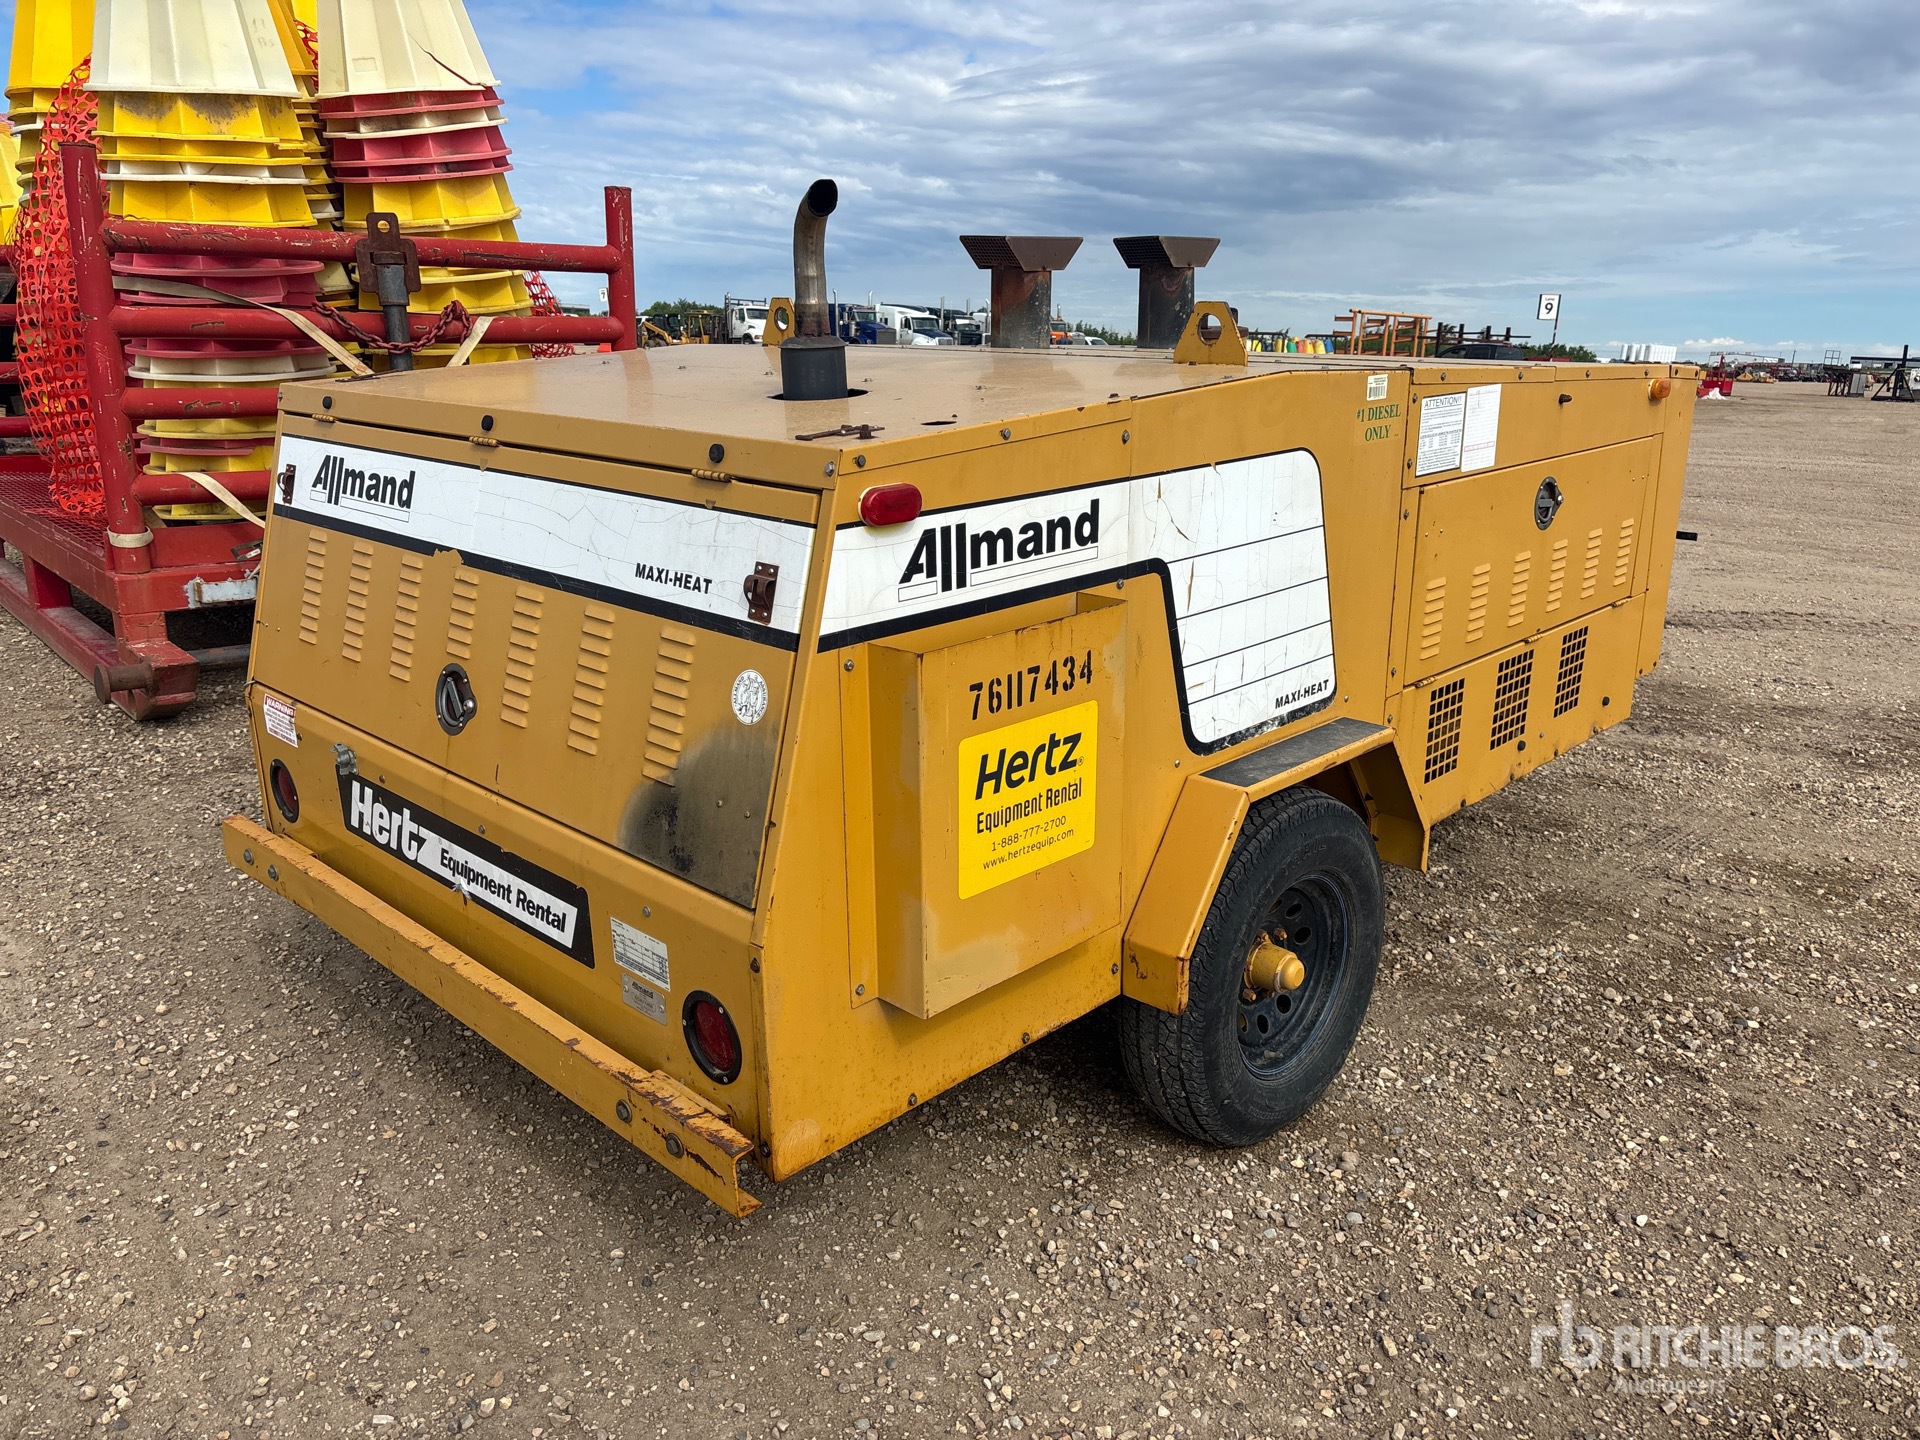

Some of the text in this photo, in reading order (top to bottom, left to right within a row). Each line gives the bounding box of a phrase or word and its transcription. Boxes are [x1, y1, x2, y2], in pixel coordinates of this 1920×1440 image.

[1544, 302, 1554, 315] 9
[1356, 404, 1401, 422] #1 DIESEL
[1364, 424, 1391, 442] ONLY
[312, 454, 416, 509] Allmand
[899, 498, 1100, 593] Allmand
[635, 562, 712, 594] MAXI-HEAT
[969, 650, 1093, 720] 76117434
[1275, 679, 1329, 709] MAXI-HEAT
[266, 697, 294, 717] WARNING
[975, 732, 1082, 800] Hertz
[976, 777, 1082, 834] Equipment Rental
[982, 828, 1074, 870] www.hertzequip.com
[991, 815, 1067, 851] 1-888-777-2700
[350, 780, 567, 933] Hertz Equipment Rental
